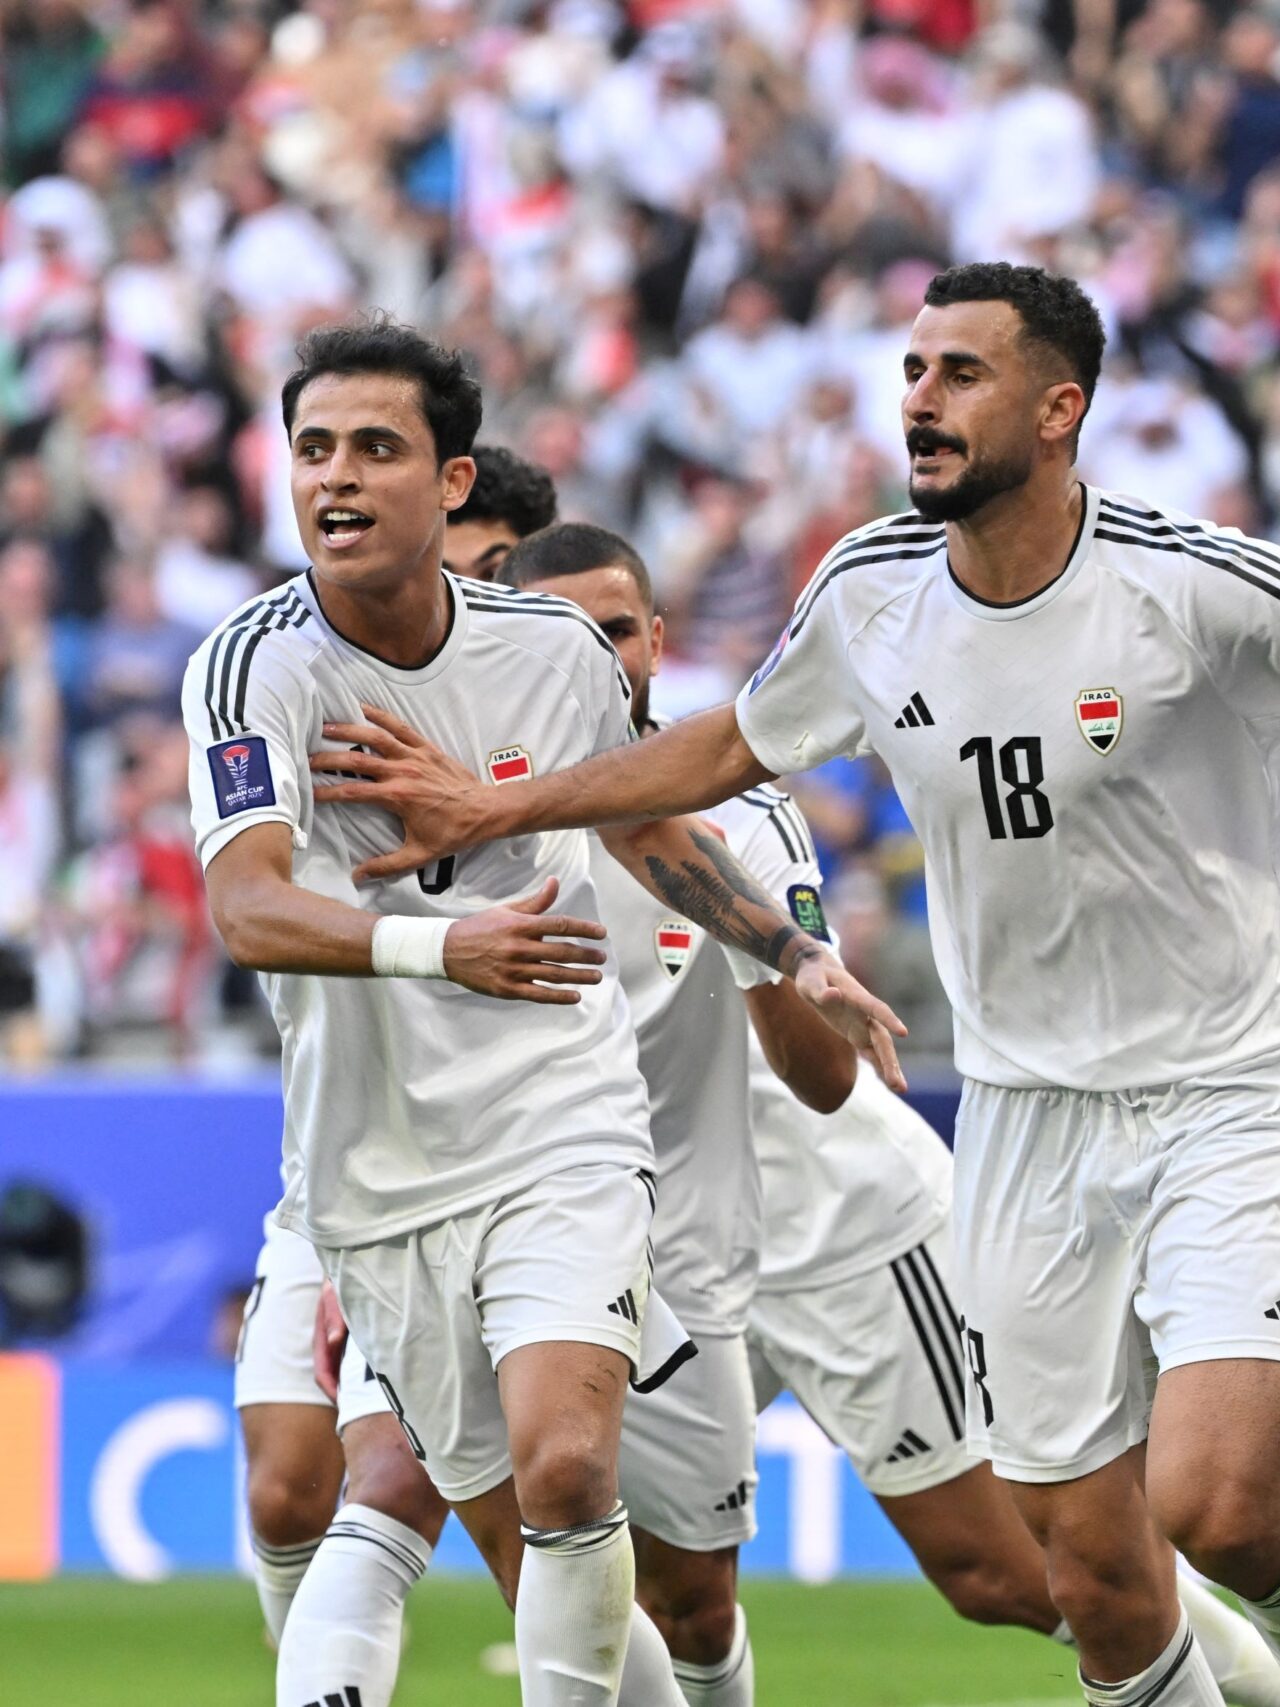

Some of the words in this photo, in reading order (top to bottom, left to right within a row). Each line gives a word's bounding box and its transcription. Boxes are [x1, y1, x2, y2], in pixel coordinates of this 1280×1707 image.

[1084, 692, 1111, 701] IRAQ
[494, 750, 519, 762] IRAQ
[225, 789, 248, 802] ASIAN
[247, 785, 265, 794] CUP
[959, 736, 1054, 840] 18
